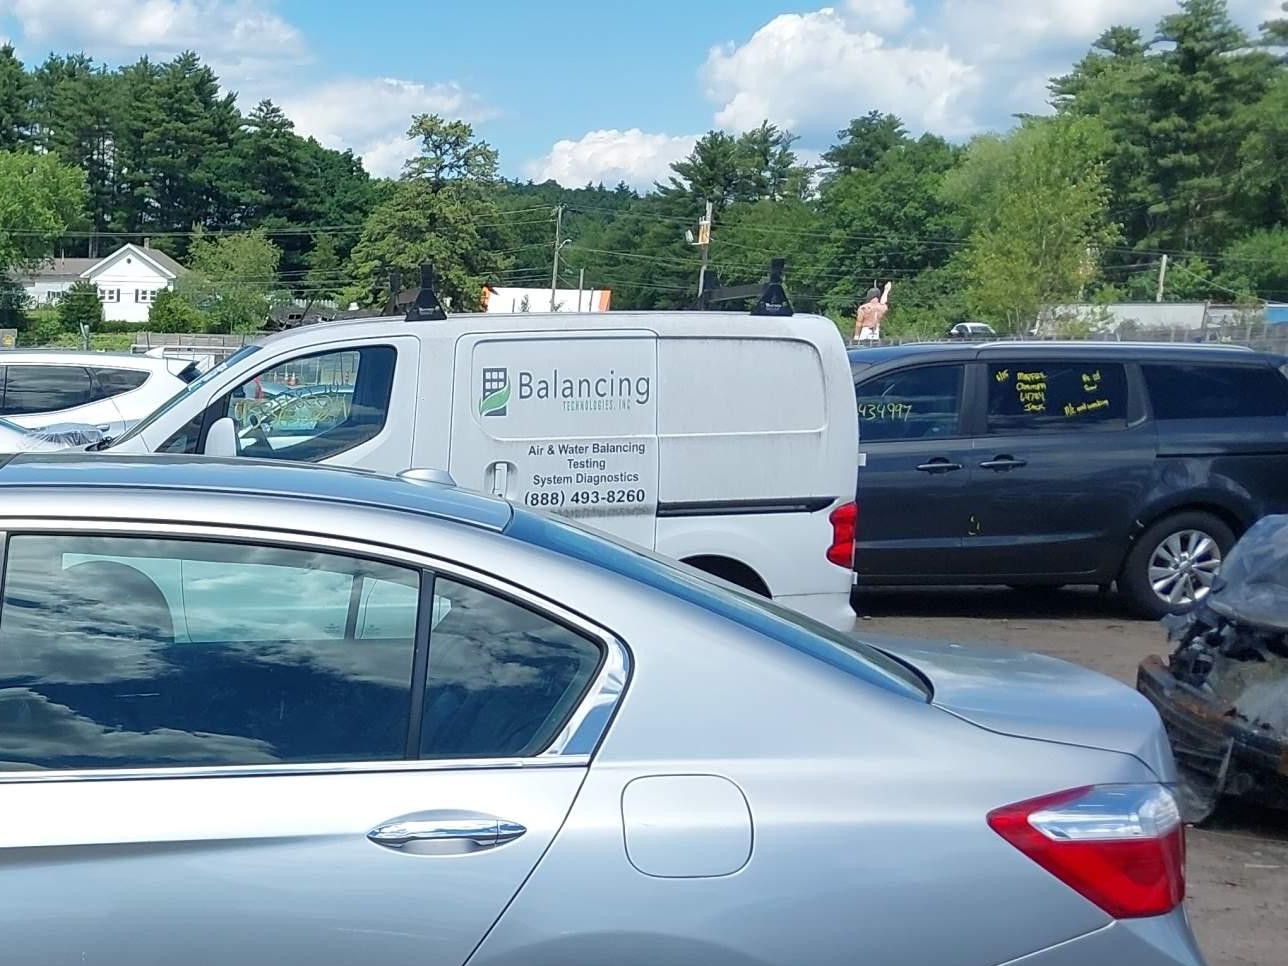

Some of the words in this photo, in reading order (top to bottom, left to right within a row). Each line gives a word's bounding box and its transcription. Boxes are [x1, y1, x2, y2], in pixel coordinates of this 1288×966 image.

[519, 369, 650, 404] Balancing
[528, 445, 544, 456] Air
[547, 444, 555, 455] &
[558, 443, 589, 455] Water
[592, 442, 646, 455] Balancing
[567, 458, 606, 471] Testing
[532, 474, 572, 488] System
[576, 472, 639, 486] Diagnostics
[524, 490, 565, 507] (888)
[570, 489, 646, 504] 493-8260
